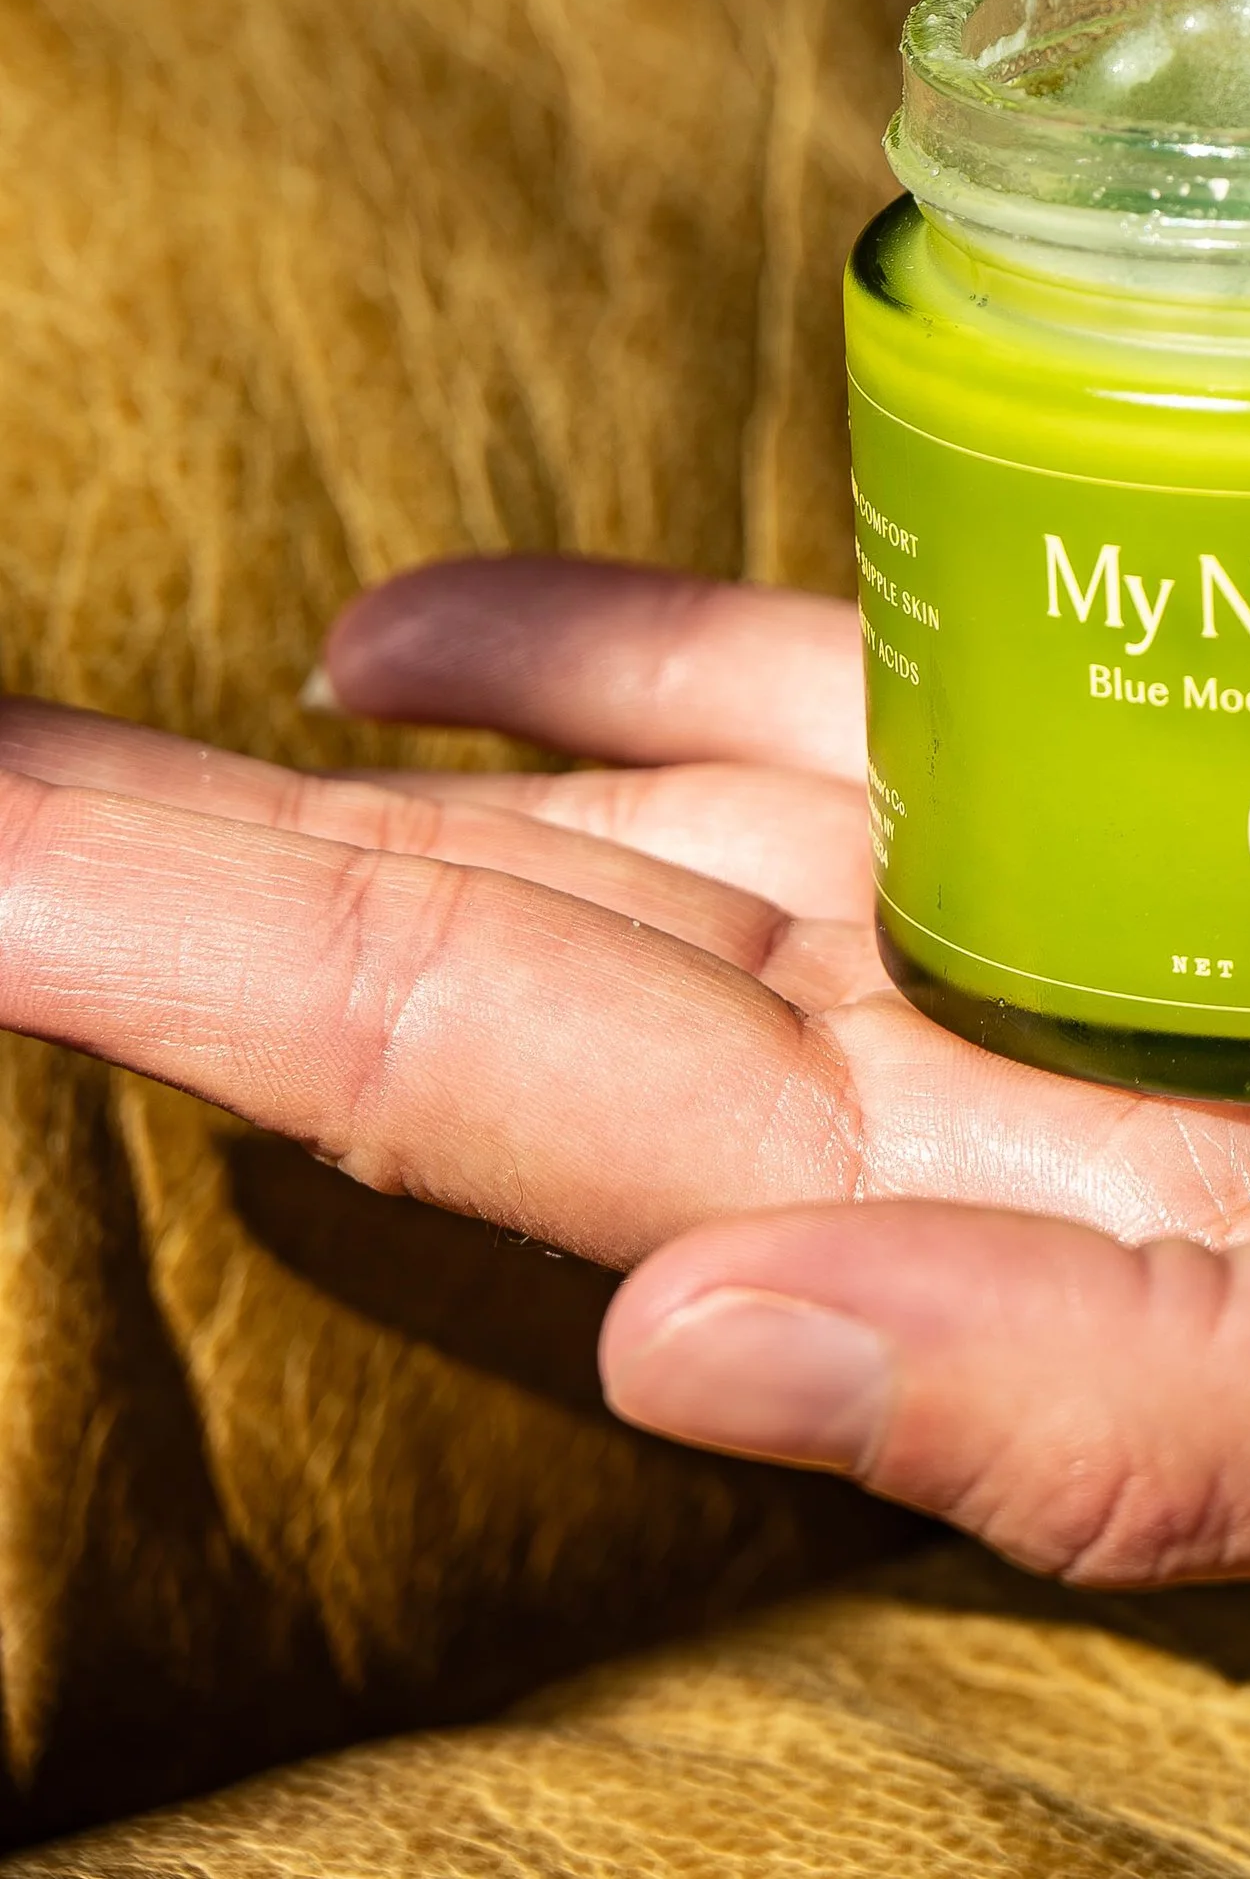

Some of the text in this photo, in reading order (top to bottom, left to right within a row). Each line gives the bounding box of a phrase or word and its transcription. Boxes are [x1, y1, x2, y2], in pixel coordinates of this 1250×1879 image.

[859, 493, 919, 558] COMFORT
[861, 551, 940, 631] SUPPLE SKIN
[1044, 533, 1175, 656] My
[878, 638, 920, 686] ACIDS
[1089, 663, 1169, 707] Blue
[1172, 954, 1235, 979] NET
